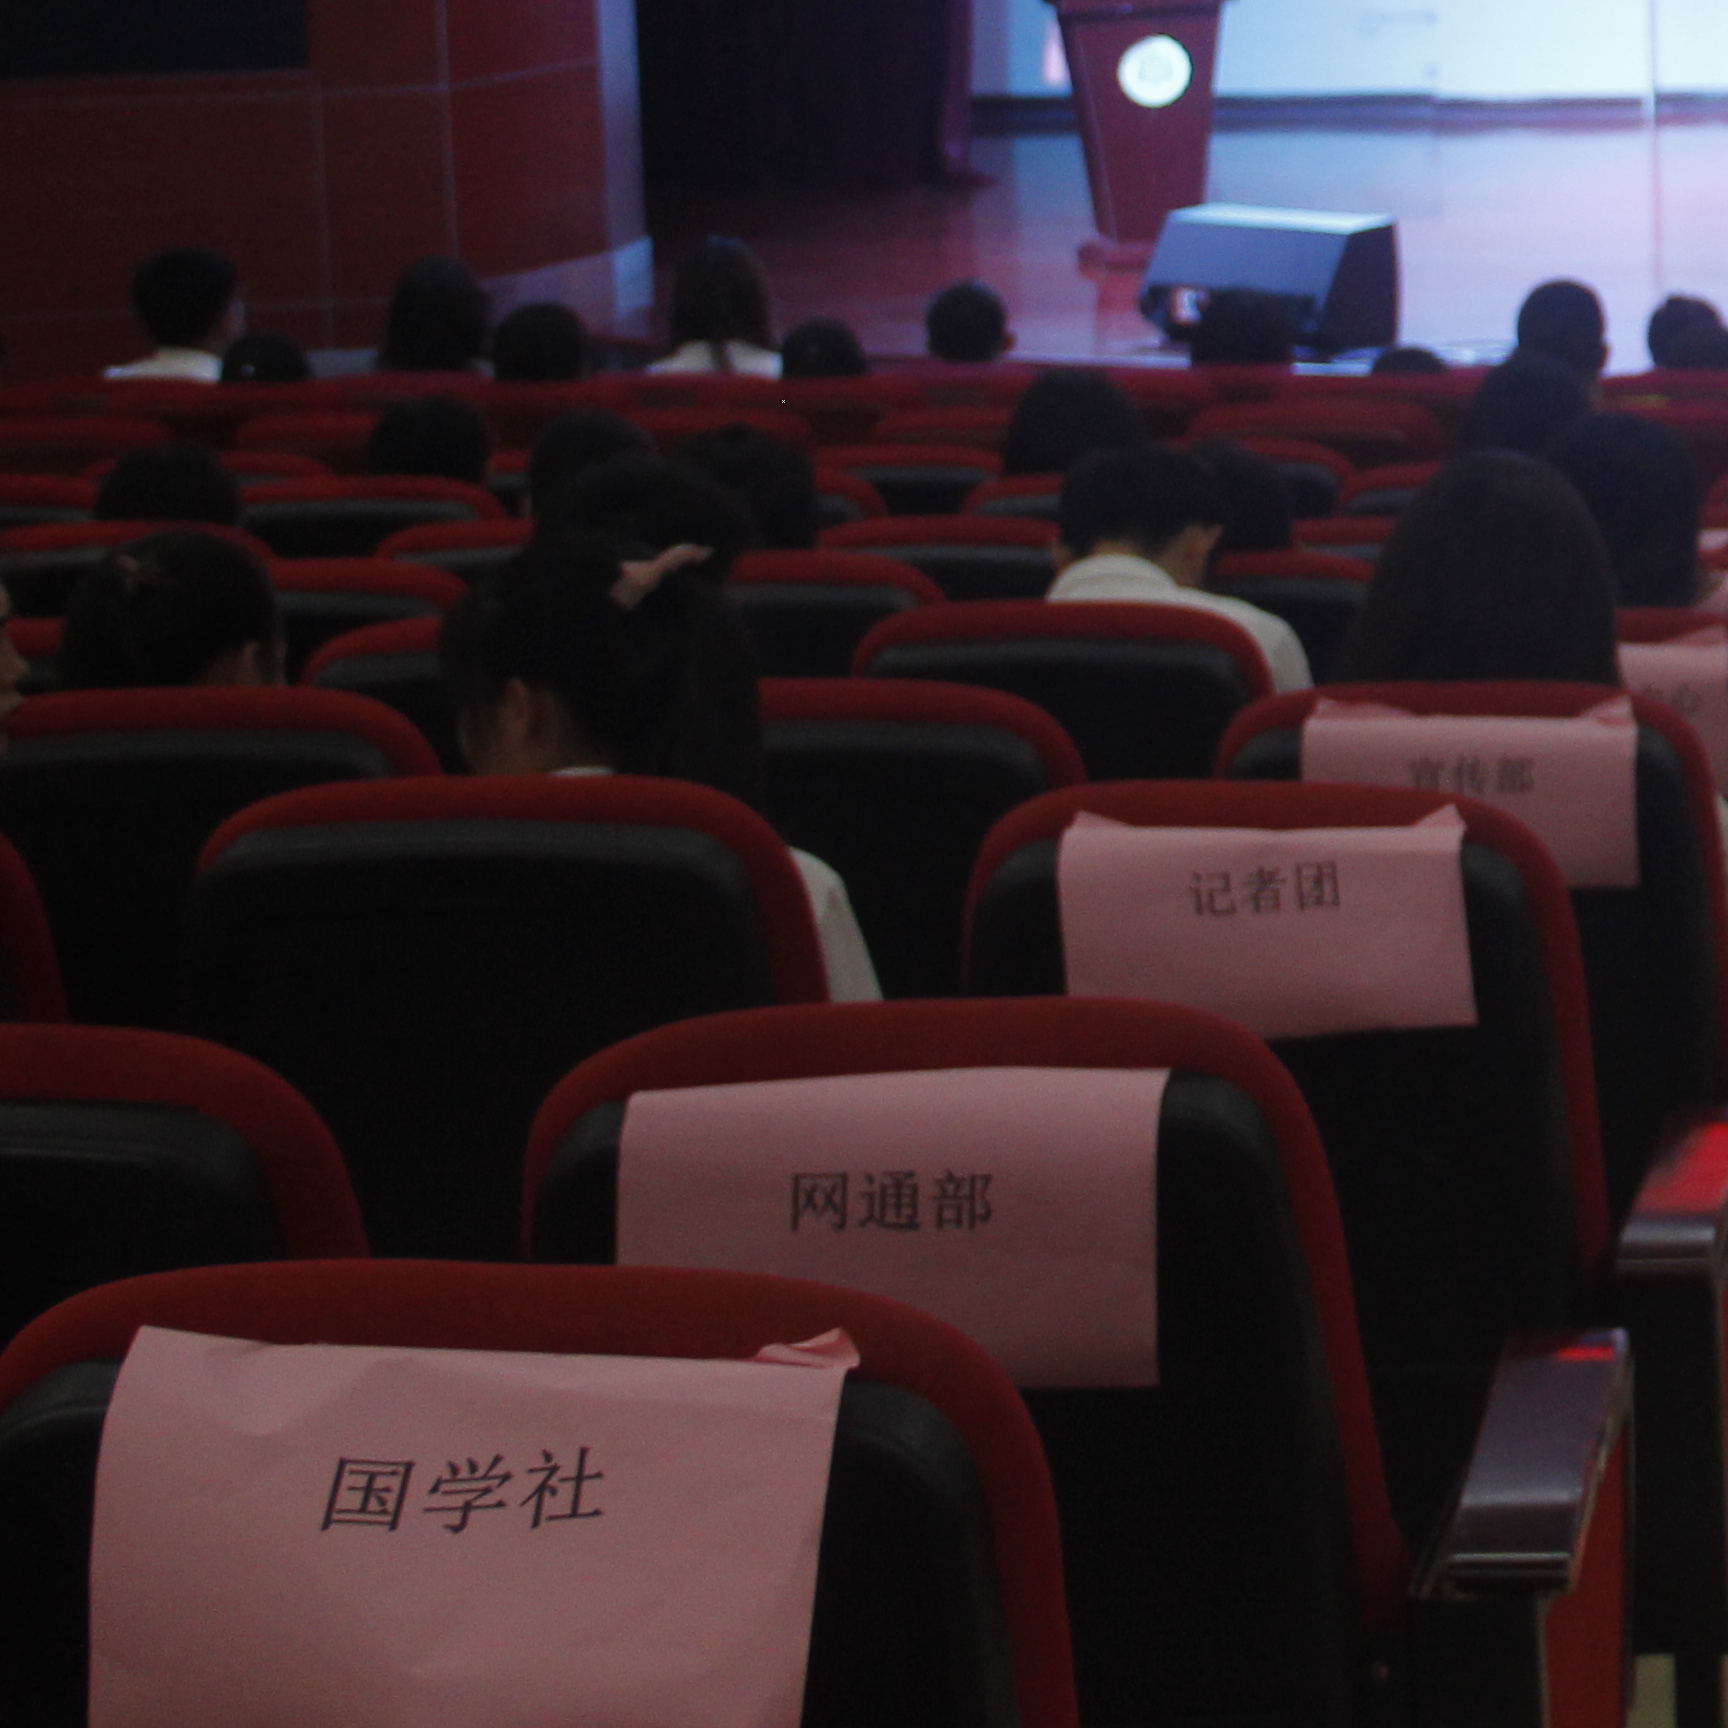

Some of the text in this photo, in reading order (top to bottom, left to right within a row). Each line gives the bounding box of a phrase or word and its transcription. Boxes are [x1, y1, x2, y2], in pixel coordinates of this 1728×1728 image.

[1188, 859, 1341, 917] 记者团
[789, 1171, 994, 1232] 网通部
[320, 1445, 605, 1534] 国学社
